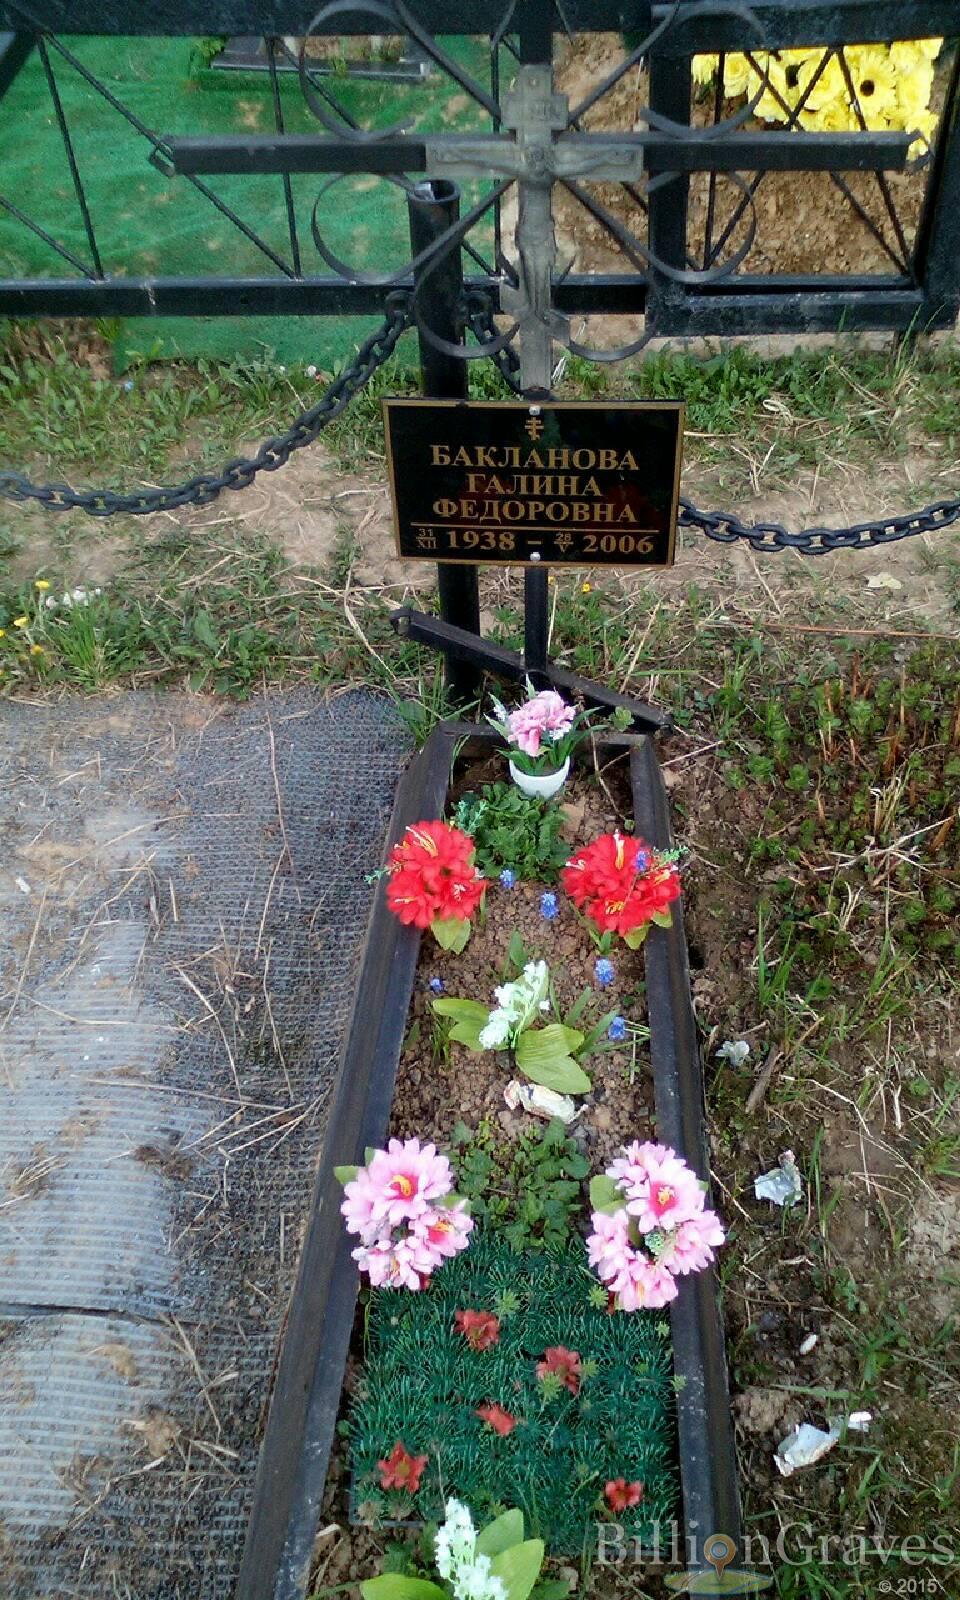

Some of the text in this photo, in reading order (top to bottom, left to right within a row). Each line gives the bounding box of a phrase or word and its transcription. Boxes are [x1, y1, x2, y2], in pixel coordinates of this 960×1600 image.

[430, 444, 639, 470] БАКЛАНОВА
[466, 473, 602, 496] ГАЛИНА
[432, 498, 638, 524] ФЕДОРОВНА
[418, 528, 434, 537] 31
[447, 530, 515, 551] 1938
[583, 535, 653, 553] 2006
